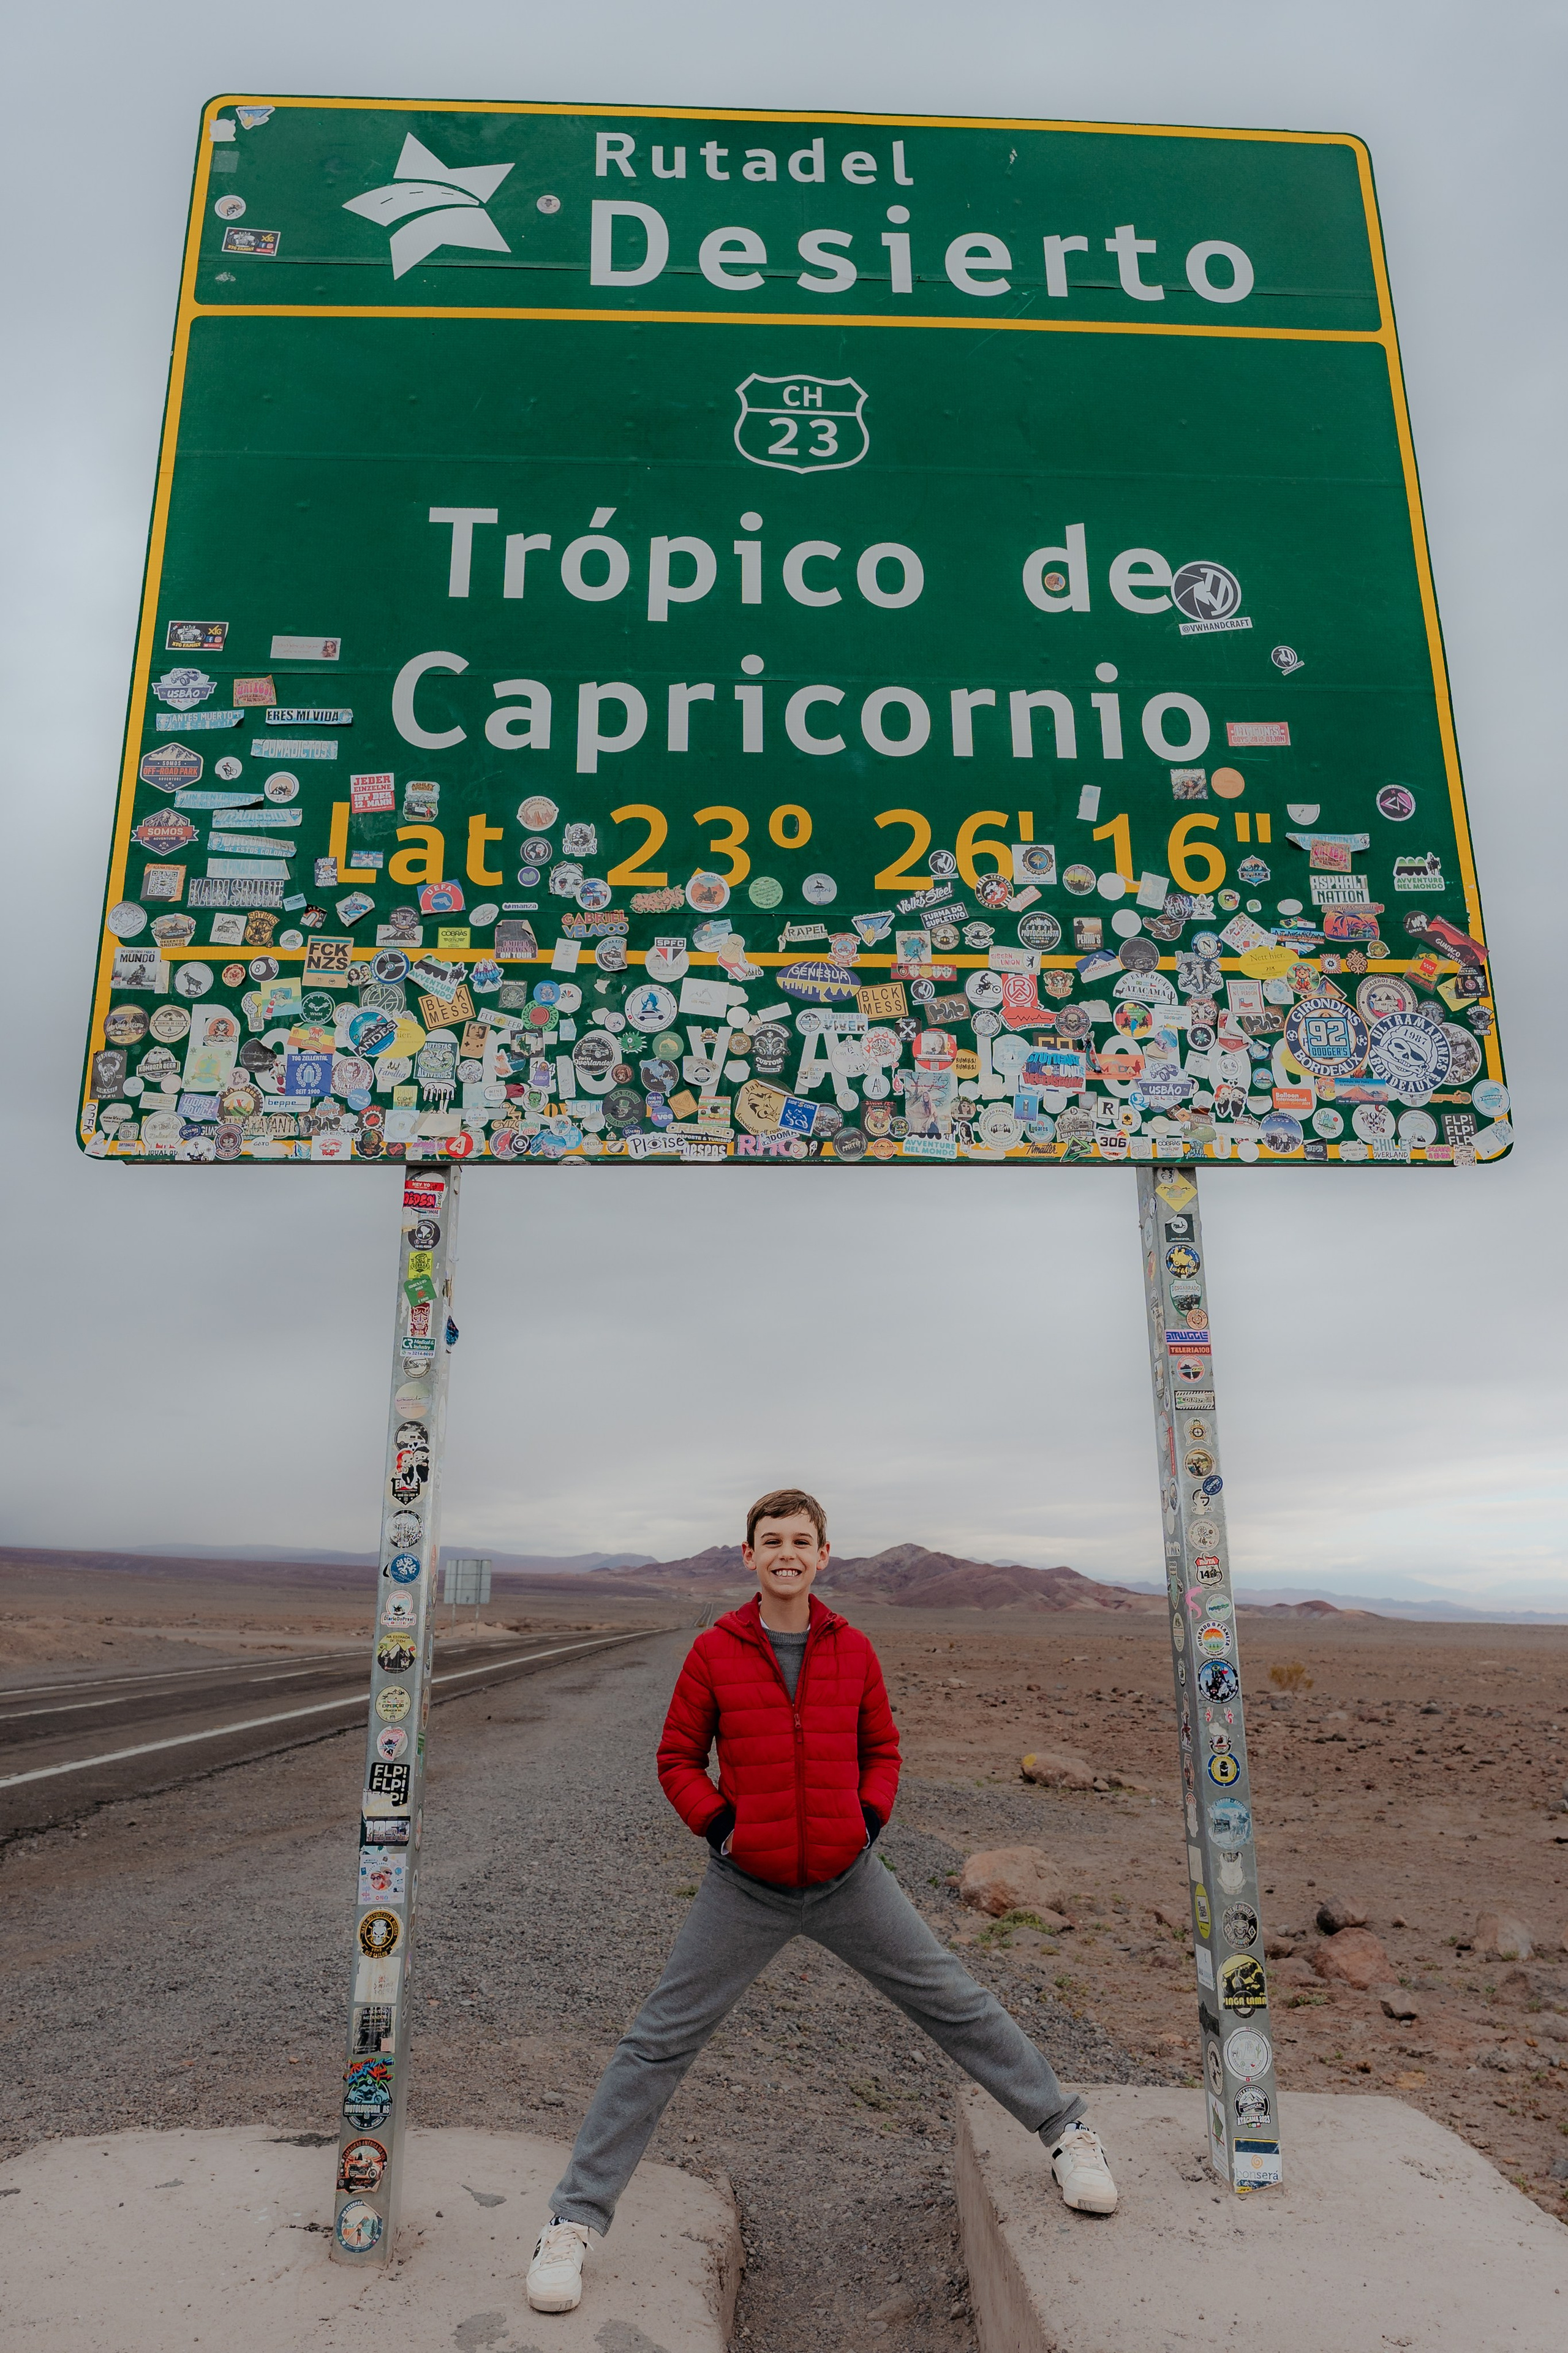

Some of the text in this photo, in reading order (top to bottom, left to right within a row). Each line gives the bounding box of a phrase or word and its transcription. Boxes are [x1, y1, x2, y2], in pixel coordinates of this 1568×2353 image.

[590, 200, 1254, 303] Desierto
[783, 386, 821, 407] CH
[769, 418, 837, 456] 23
[429, 506, 1172, 622] Trópico de
[1182, 618, 1250, 633] @VWHANDCRAFT
[167, 688, 201, 698] USBÃO
[172, 711, 233, 722] ANTES MUERTO
[266, 710, 339, 722] ERES MI VIDA
[393, 651, 1210, 773] Capricornio
[143, 767, 198, 776] OFF-ROAD PARK
[353, 775, 391, 785] JEDER
[367, 799, 393, 808] MANN
[329, 802, 503, 886] Lat
[261, 848, 292, 857] COLORES
[1311, 875, 1366, 889] ASPHALT
[427, 884, 452, 896] UEFA
[1317, 890, 1366, 903] NATION
[562, 909, 629, 925] GABRIEL
[923, 906, 961, 921] TURMA DO
[926, 913, 966, 927] SUPLETIVO
[562, 921, 629, 938] VELASCO
[788, 925, 827, 937] RAPEL
[308, 942, 349, 957] FCK
[657, 939, 684, 948] SPFC
[1435, 938, 1461, 957] GUANACO
[120, 953, 155, 963] MUNDO
[307, 956, 349, 970] NZS
[1250, 952, 1286, 962] Nett hier.
[791, 966, 848, 980] GENESUR
[409, 969, 456, 994] AVVENTURE
[1364, 978, 1389, 992] VIAJEROS
[422, 983, 453, 1000] MONDO
[862, 987, 901, 1002] BLCK
[1125, 986, 1166, 996] ATACAMA
[429, 1002, 470, 1024] MESS
[863, 1000, 902, 1015] MESS
[1291, 997, 1362, 1027] GIRONDINS
[356, 1021, 397, 1056] ANDES
[1308, 1021, 1347, 1046] 92
[1403, 1029, 1427, 1046] 1987
[1371, 1013, 1448, 1073] ULTRAMARINES
[755, 1057, 783, 1066] CUSTOM
[1294, 1049, 1363, 1077] BORDEAUX
[417, 1068, 452, 1078] ALVIVERDES
[1149, 1085, 1182, 1095] USBÃO
[183, 1096, 217, 1107] WORST
[268, 1098, 296, 1108] beppe
[183, 1105, 213, 1116] ADVICE
[1444, 1114, 1473, 1125] FLP!
[1446, 1125, 1475, 1136] FLP!
[905, 1139, 956, 1149] AVVENTURE
[1099, 1136, 1127, 1147] 306
[1373, 1138, 1408, 1152] CHILE
[921, 1147, 955, 1156] MONDO
[374, 1764, 408, 1778] FLP!
[372, 1777, 406, 1792] FLP!
[1237, 2115, 1271, 2126] ATACAMA 2023
